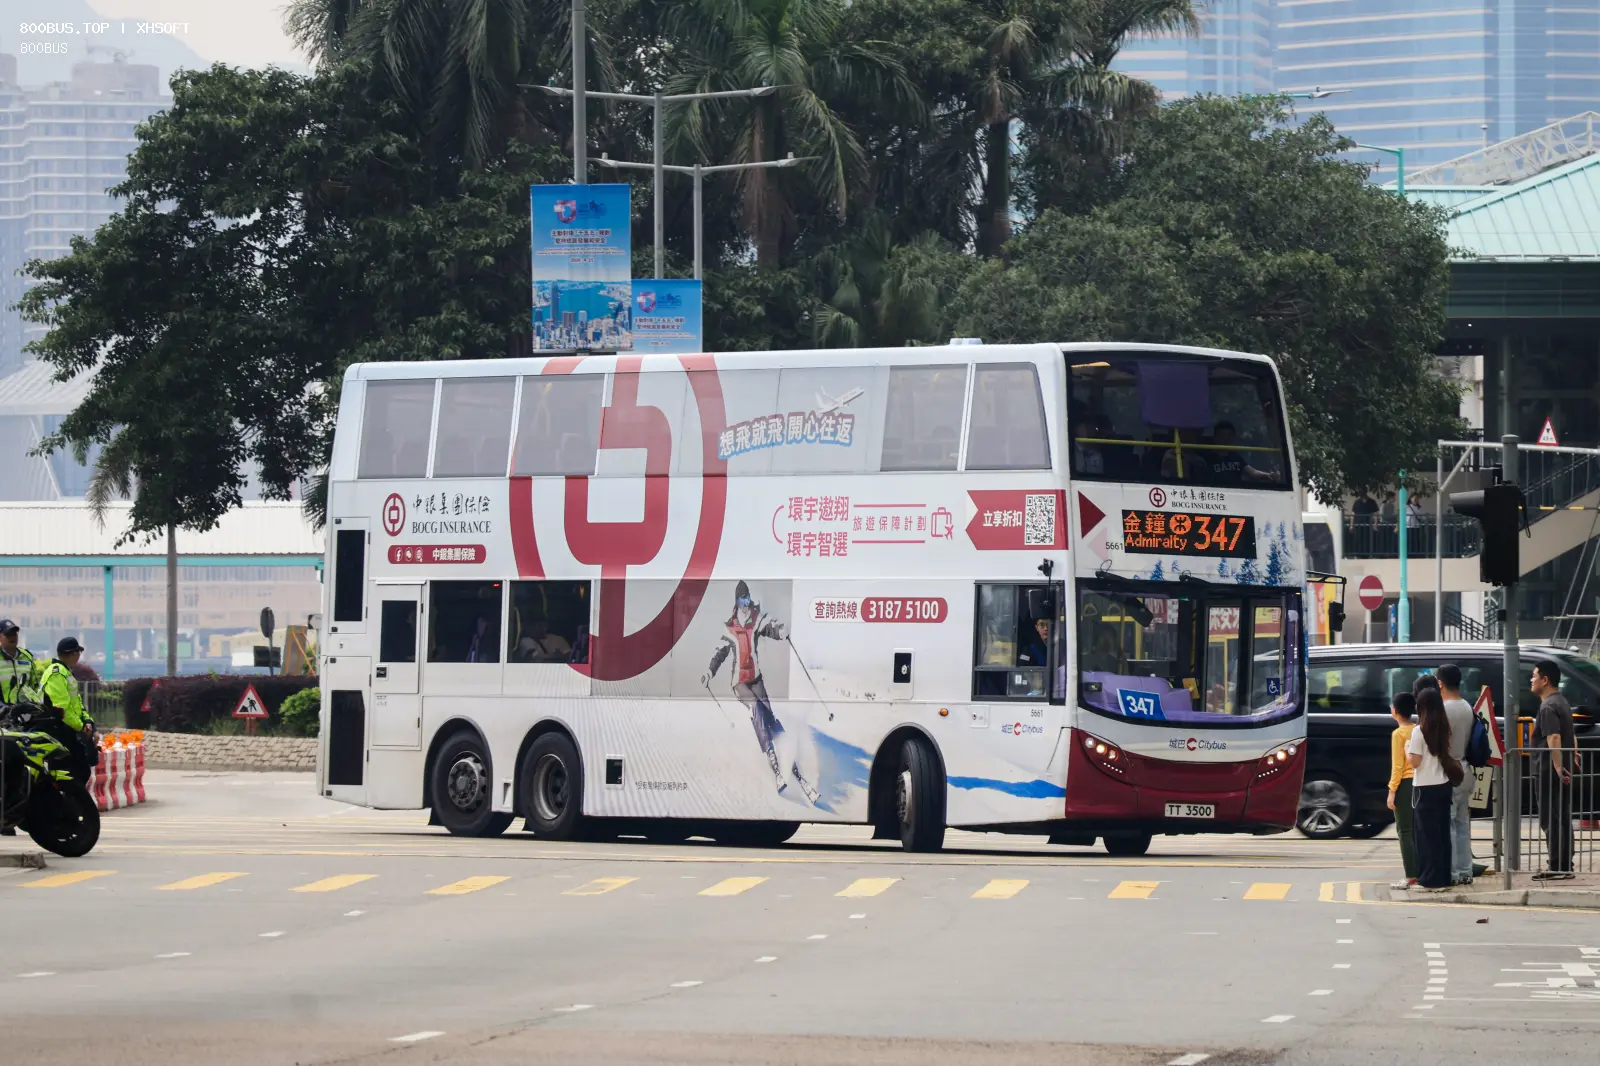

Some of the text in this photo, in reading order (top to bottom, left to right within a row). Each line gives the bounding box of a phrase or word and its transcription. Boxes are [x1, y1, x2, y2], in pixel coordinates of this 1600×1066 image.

[720, 414, 853, 456] 想飛就飛 開心往返
[788, 496, 849, 522] 環宇遨翔
[1191, 502, 1227, 511] INSURANCE
[412, 520, 491, 534] BOCG INSURANCE
[852, 515, 927, 531] 旅遊保障計劃
[982, 509, 1023, 528] 立享折扣
[1123, 511, 1166, 534] 金鐘
[1124, 533, 1188, 551] Admiralty
[1193, 516, 1246, 551] 347
[786, 531, 848, 557] 環宇智選
[1105, 542, 1123, 550] 5661
[814, 600, 858, 619] 查詢熱線
[868, 600, 939, 619] 3187 5100
[1030, 709, 1043, 718] 5661
[1126, 695, 1155, 716] 347
[1021, 724, 1043, 734] Citybus
[1168, 738, 1186, 749] 城巴
[1198, 739, 1227, 750] Citybus
[1168, 804, 1212, 817] TT 3500
